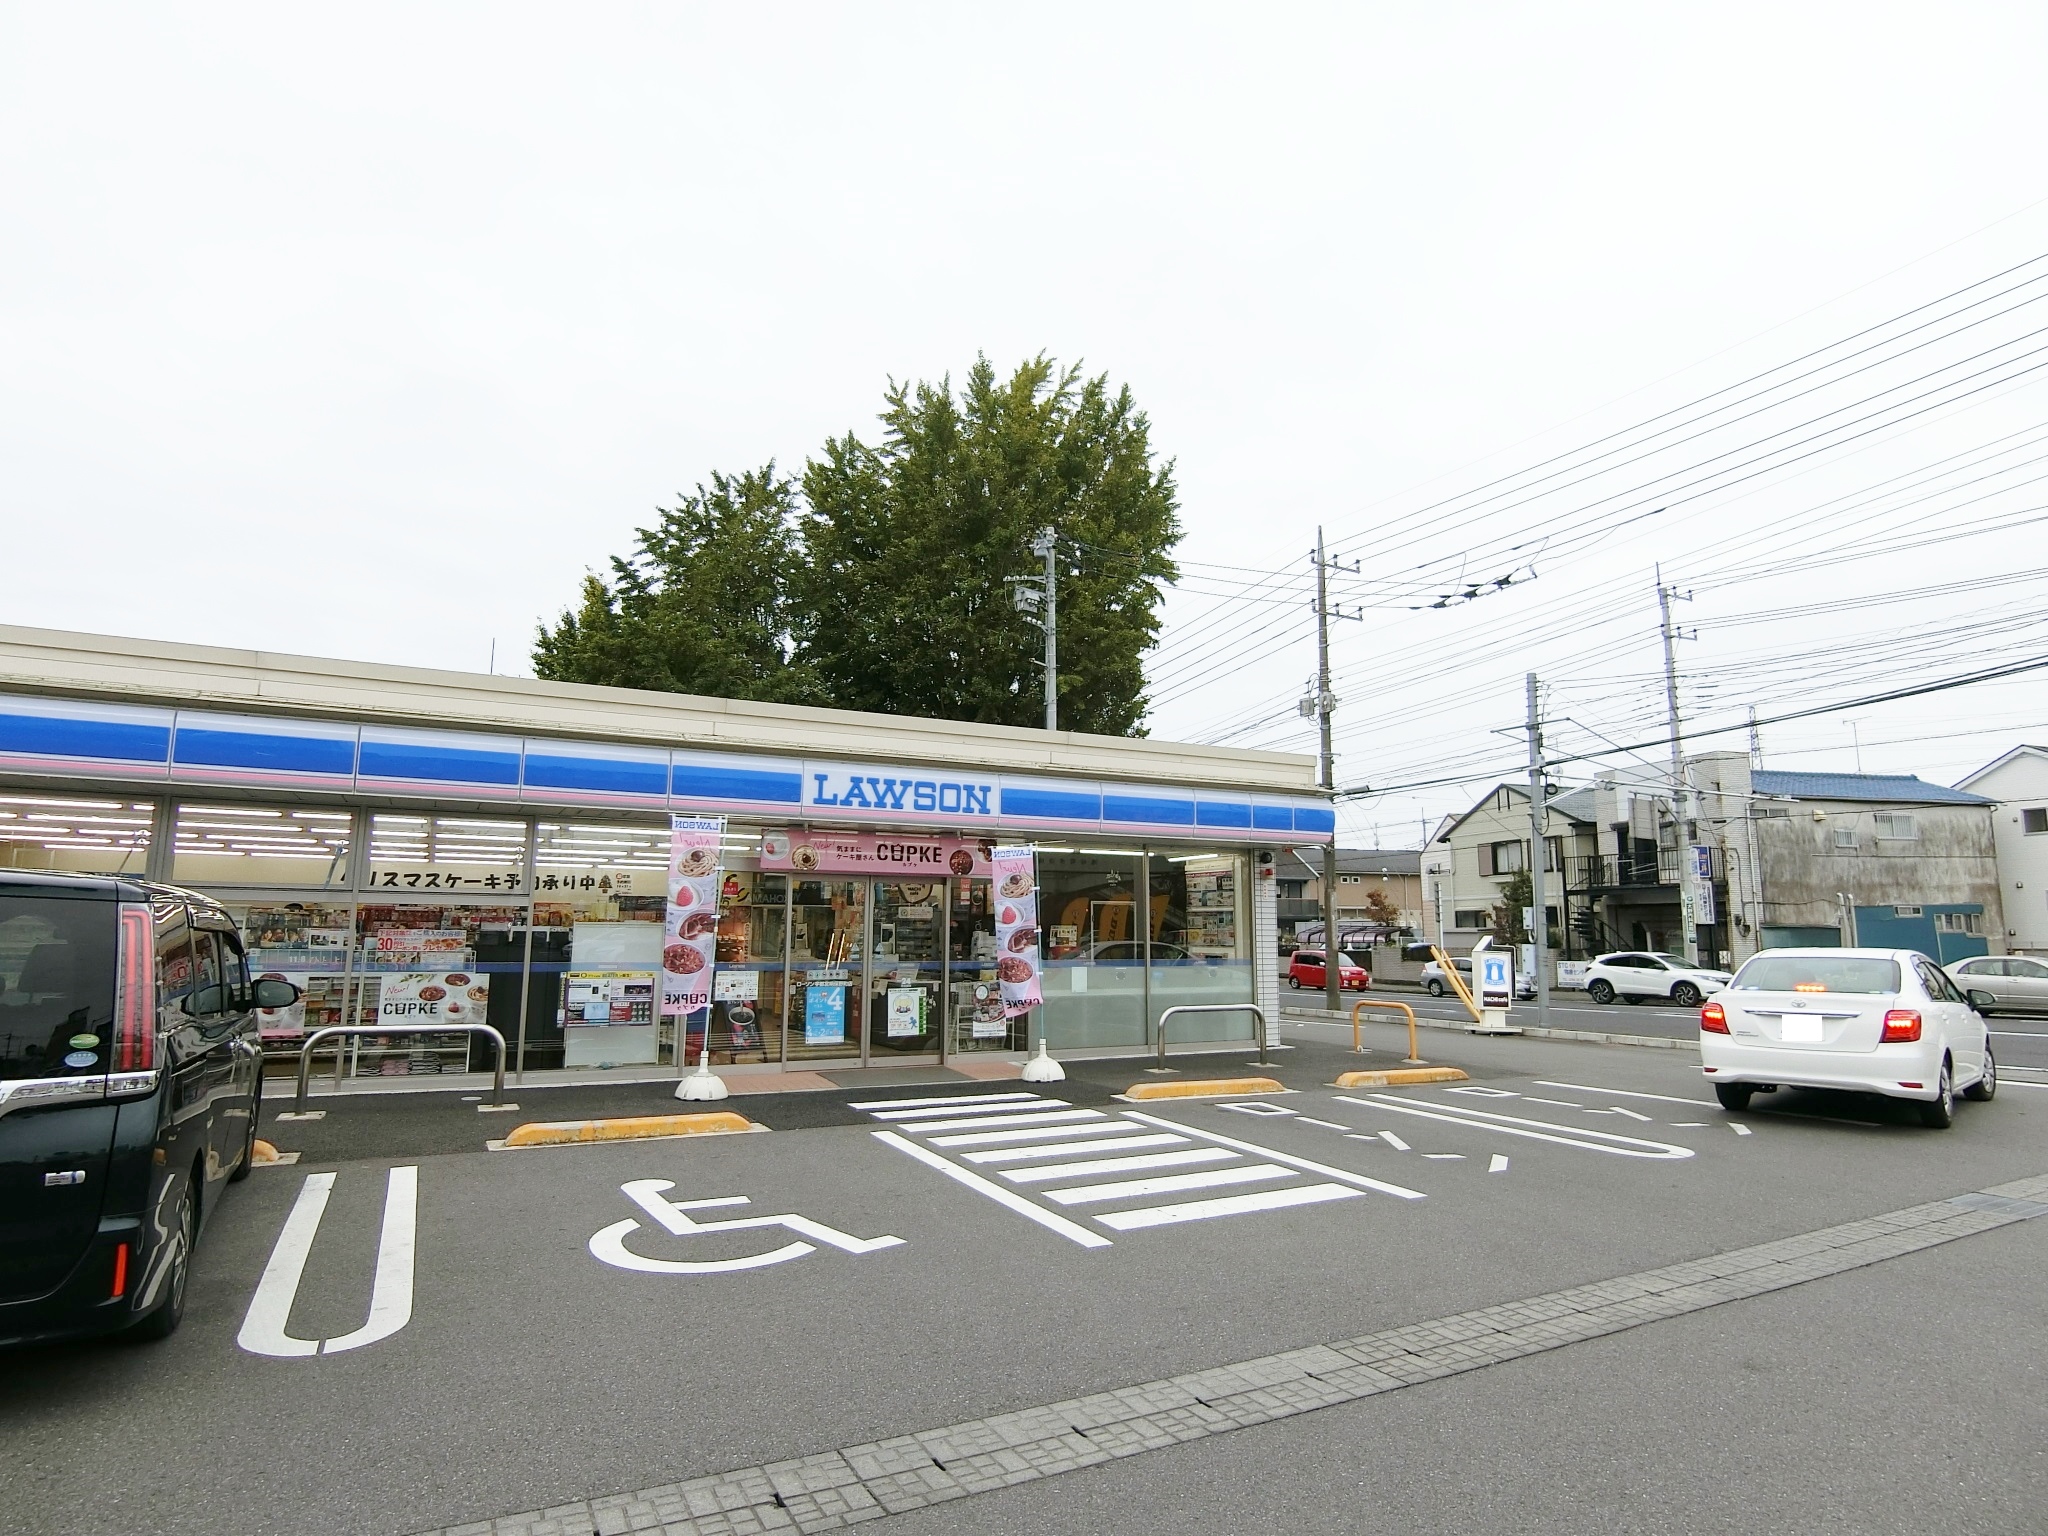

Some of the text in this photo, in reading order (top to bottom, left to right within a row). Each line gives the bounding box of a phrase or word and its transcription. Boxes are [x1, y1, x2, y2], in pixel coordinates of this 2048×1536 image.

[813, 774, 991, 815] LAWSON
[836, 853, 874, 861] ケーキ屋さん
[876, 843, 942, 863] CUPKE
[340, 871, 596, 891] スマスケーキ予承り中
[377, 937, 393, 951] 30
[385, 984, 411, 997] New!
[827, 987, 843, 1011] 4
[383, 1002, 438, 1015] CUPKE
